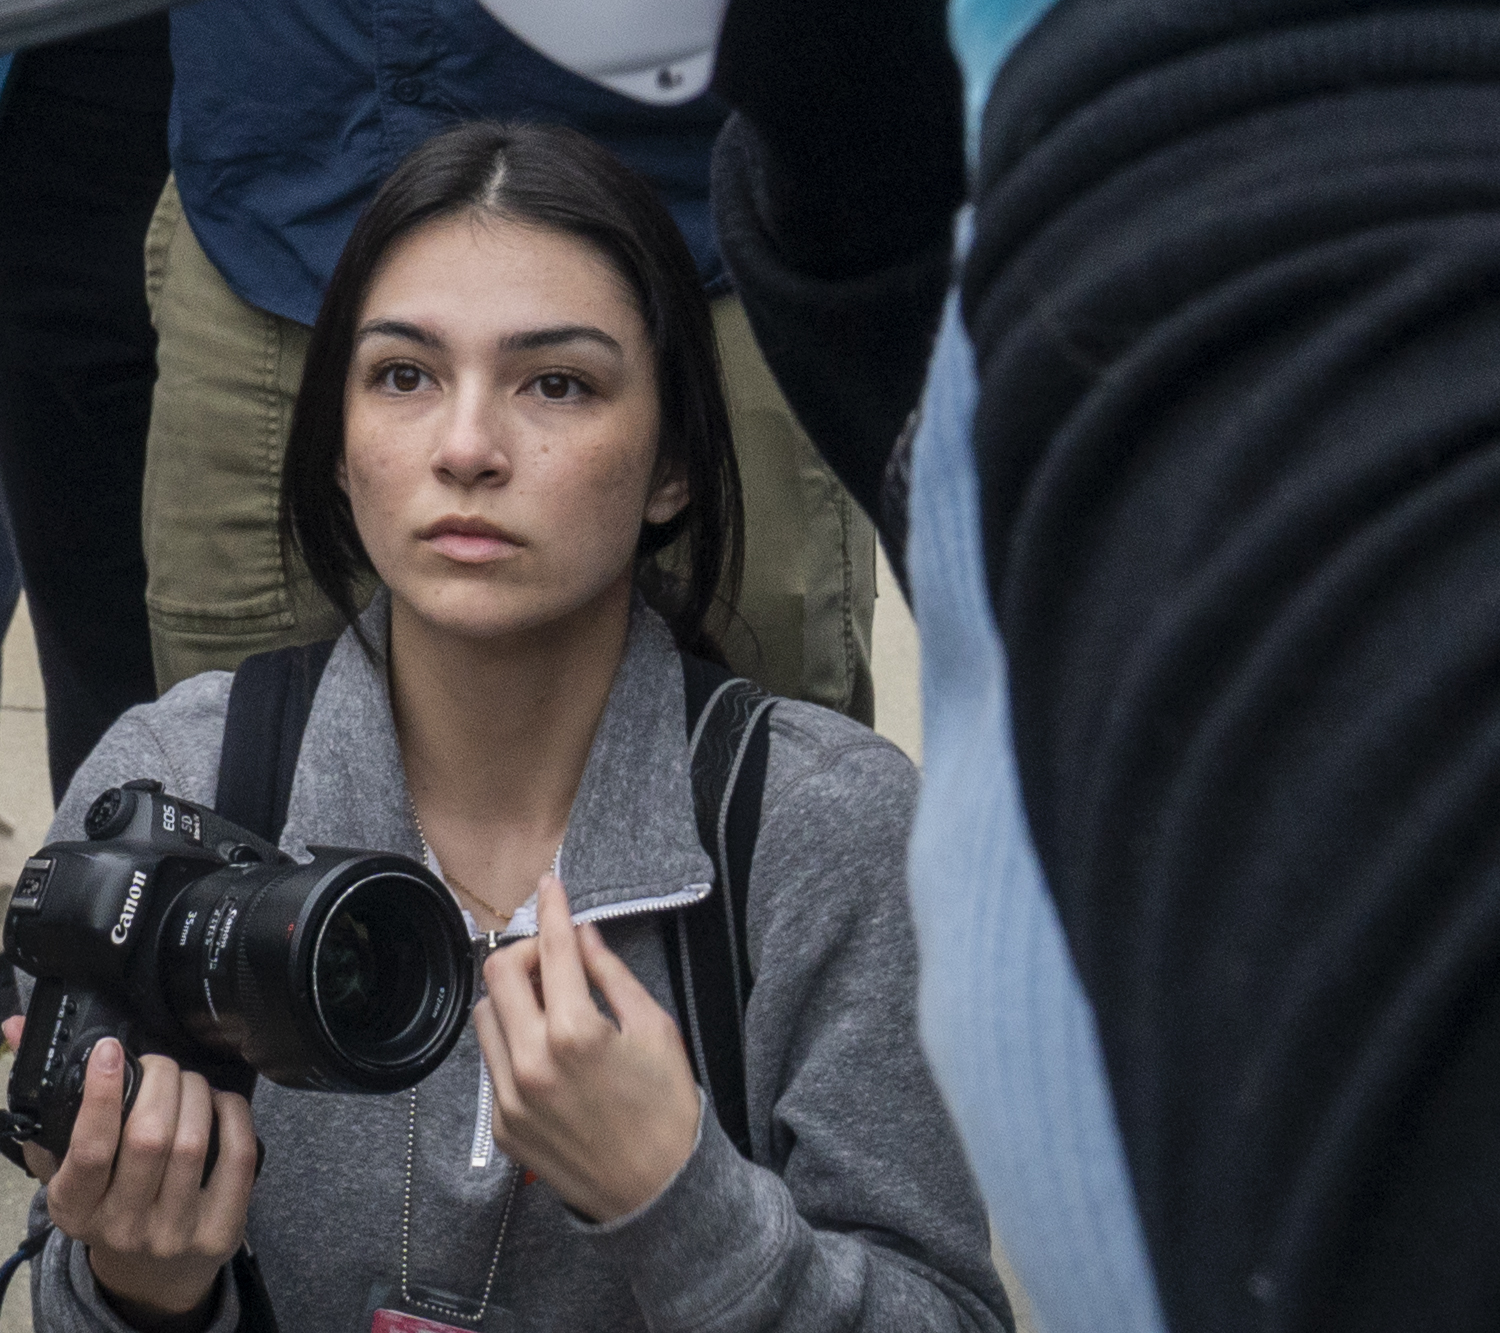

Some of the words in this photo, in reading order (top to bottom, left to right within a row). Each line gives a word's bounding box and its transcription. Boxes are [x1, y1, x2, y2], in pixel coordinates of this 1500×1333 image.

[163, 804, 175, 832] EOS
[181, 815, 192, 834] 5D
[111, 870, 147, 946] Canon
[179, 910, 198, 947] 35mm
